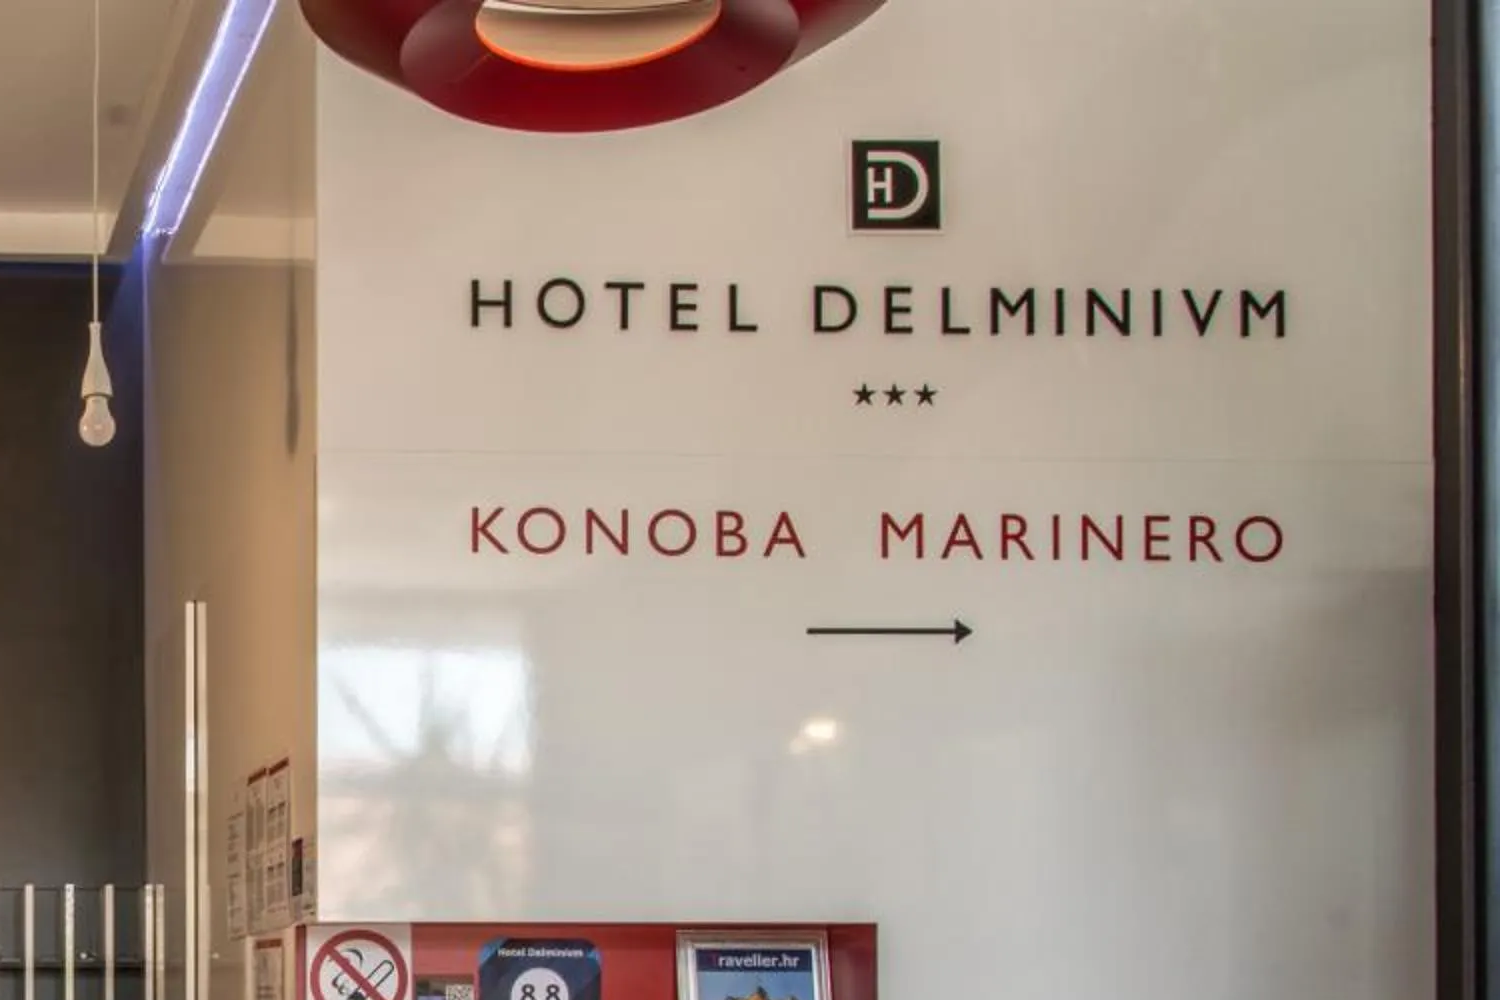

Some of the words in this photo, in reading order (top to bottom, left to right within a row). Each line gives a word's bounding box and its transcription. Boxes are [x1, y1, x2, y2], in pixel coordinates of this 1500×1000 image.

[470, 278, 758, 333] HOTEL
[813, 285, 1286, 338] DELMINIVM
[470, 506, 806, 560] KONOBA
[880, 511, 1283, 562] MARINERO
